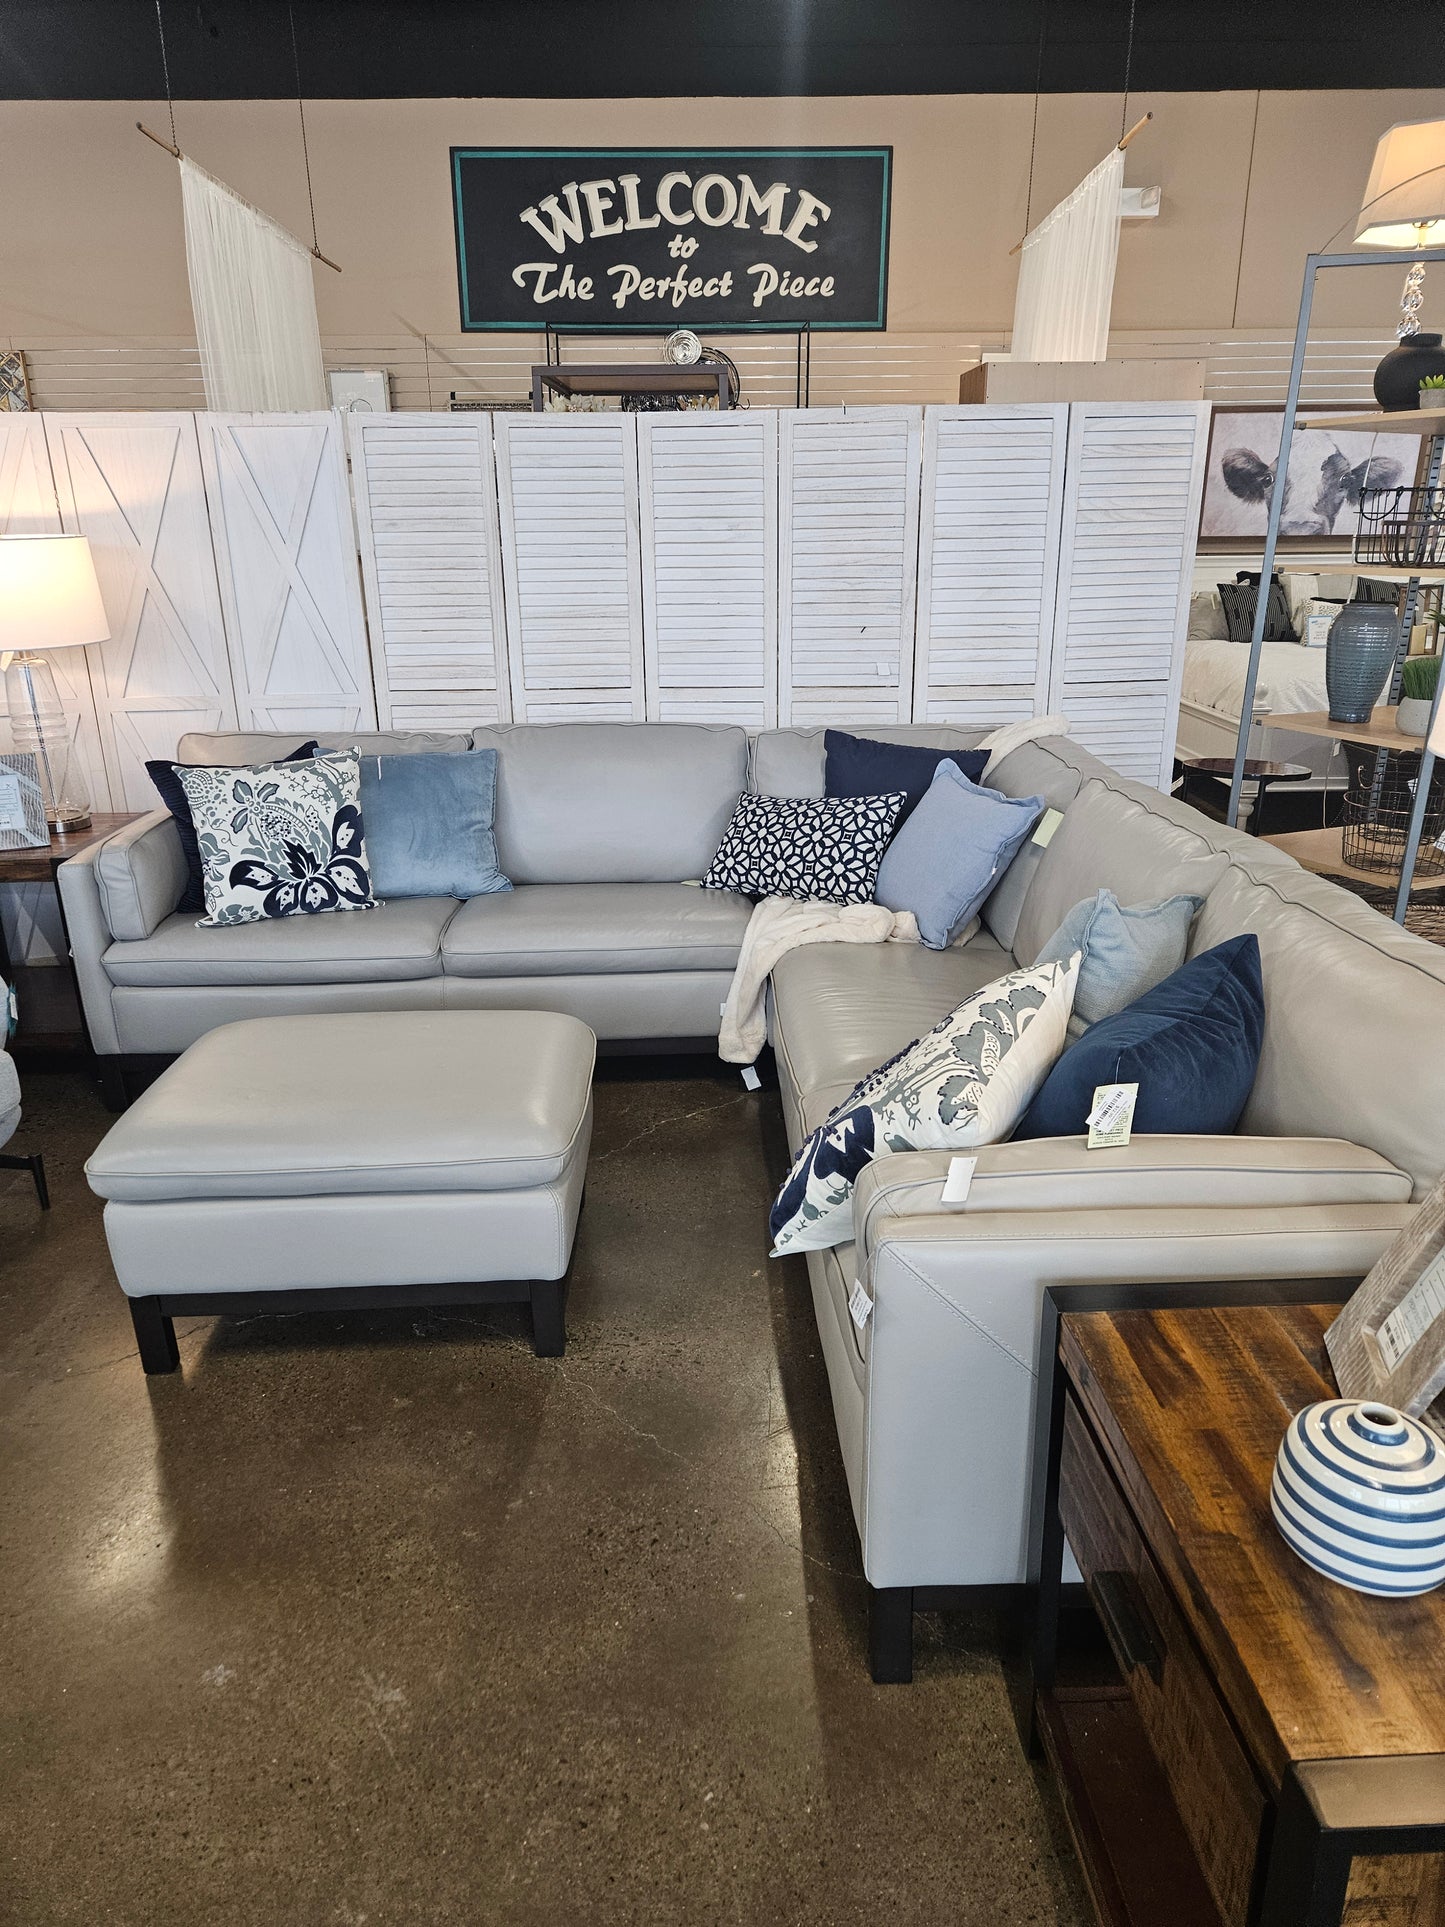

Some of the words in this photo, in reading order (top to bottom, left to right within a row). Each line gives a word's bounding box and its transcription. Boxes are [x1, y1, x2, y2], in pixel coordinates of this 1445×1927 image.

[519, 170, 832, 255] WELCOME
[667, 233, 700, 259] to
[511, 262, 595, 304] The
[606, 263, 733, 309] Perfect
[746, 262, 835, 308] Piece
